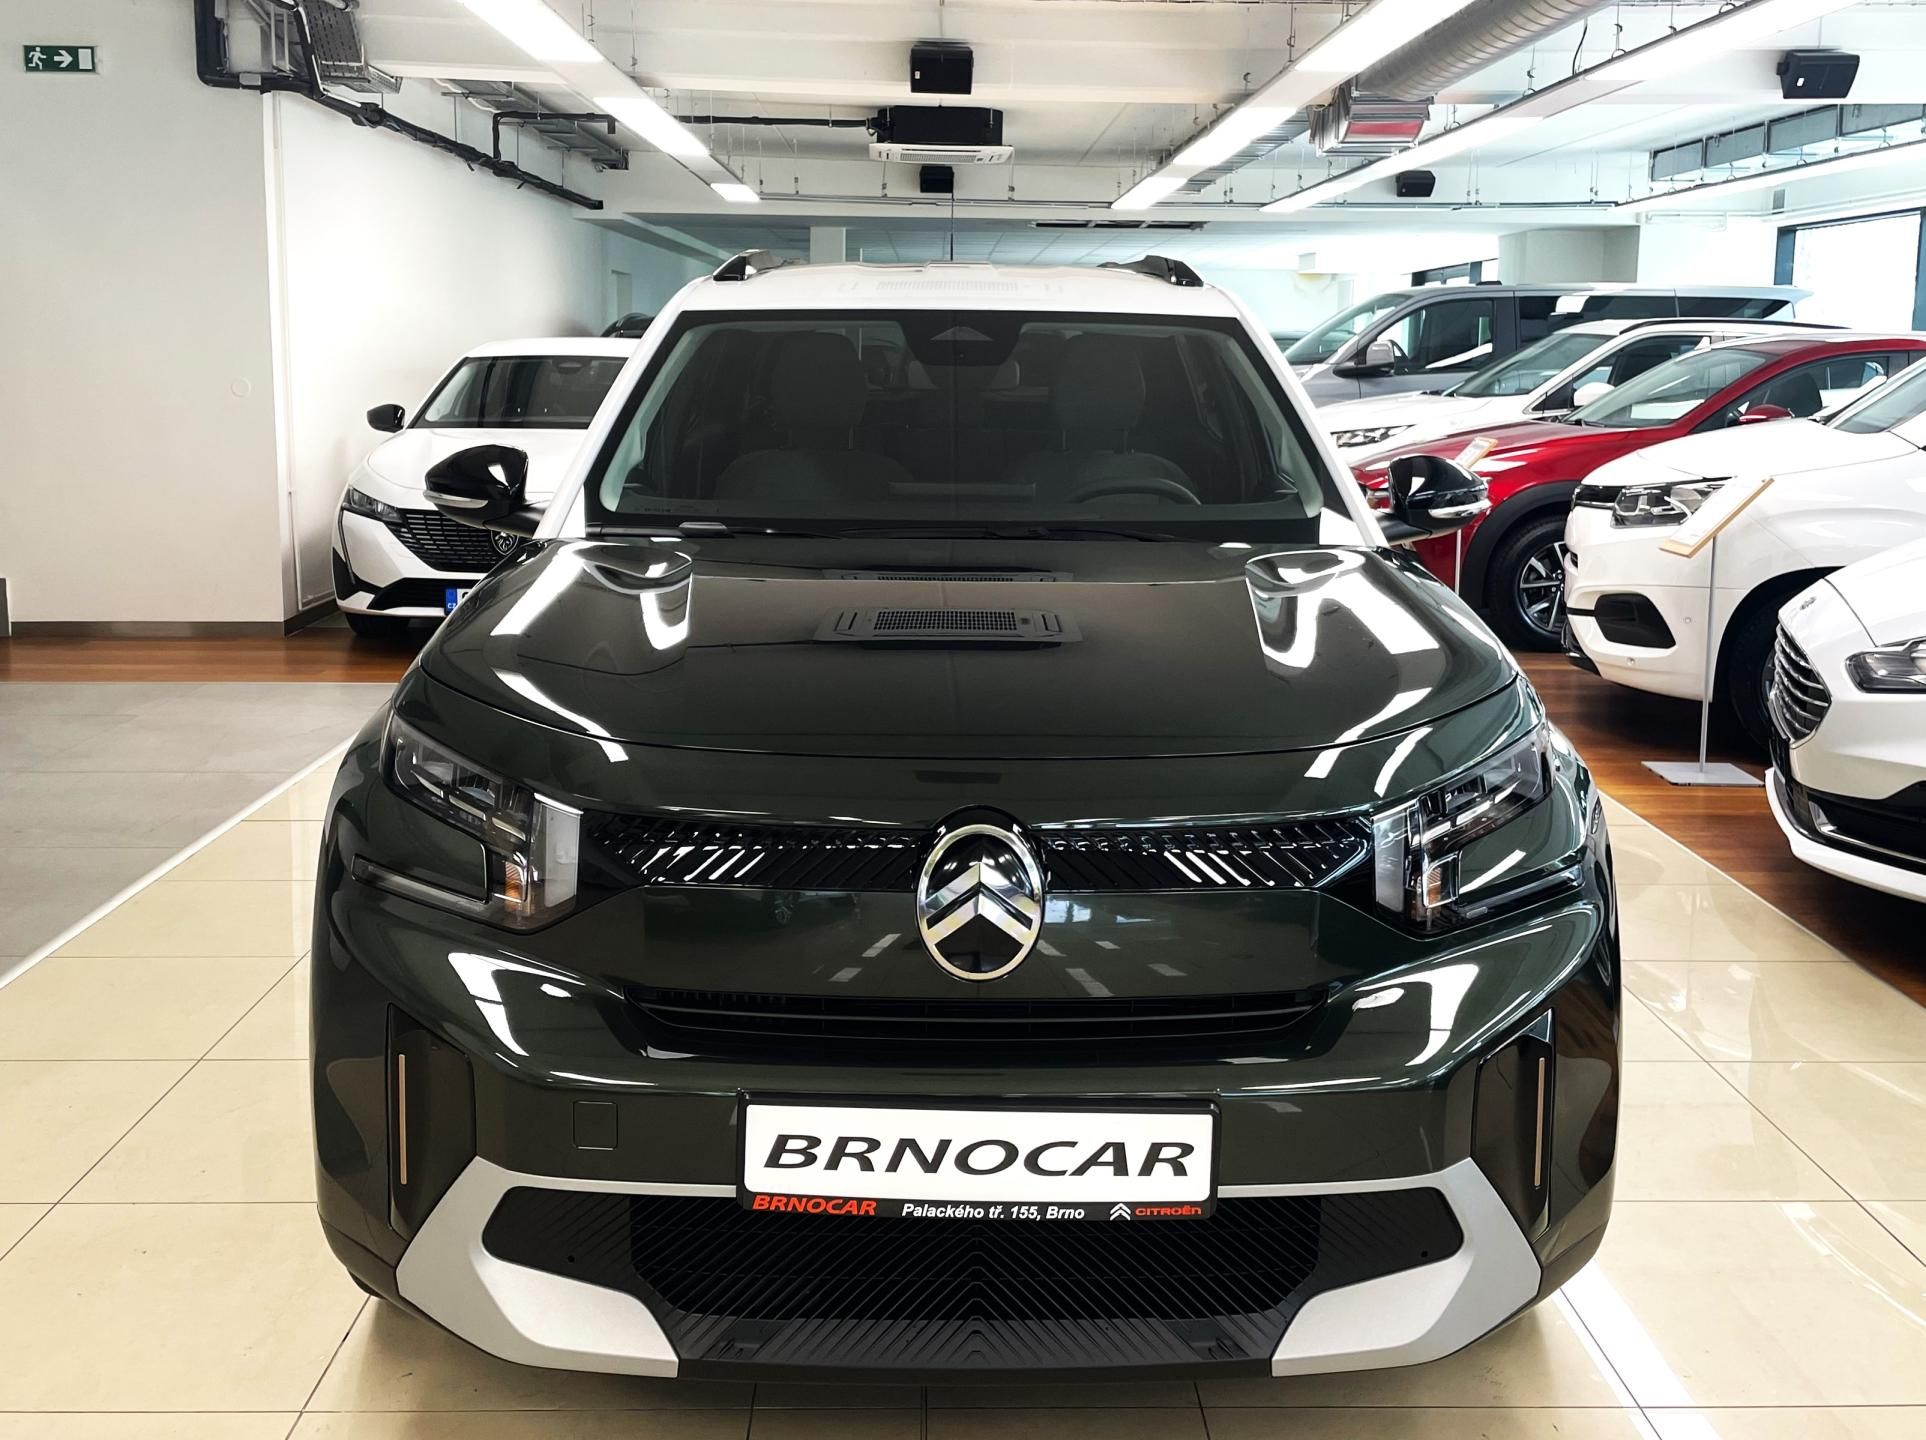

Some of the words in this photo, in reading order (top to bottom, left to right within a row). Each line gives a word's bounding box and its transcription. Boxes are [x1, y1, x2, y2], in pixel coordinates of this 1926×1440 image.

[764, 1134, 1195, 1177] BRNOCAR
[752, 1195, 876, 1215] BRNOCAR
[902, 1203, 983, 1218] Palackého
[989, 1205, 1005, 1218] tř.
[1010, 1206, 1041, 1221] 155,
[1046, 1207, 1085, 1219] Brno
